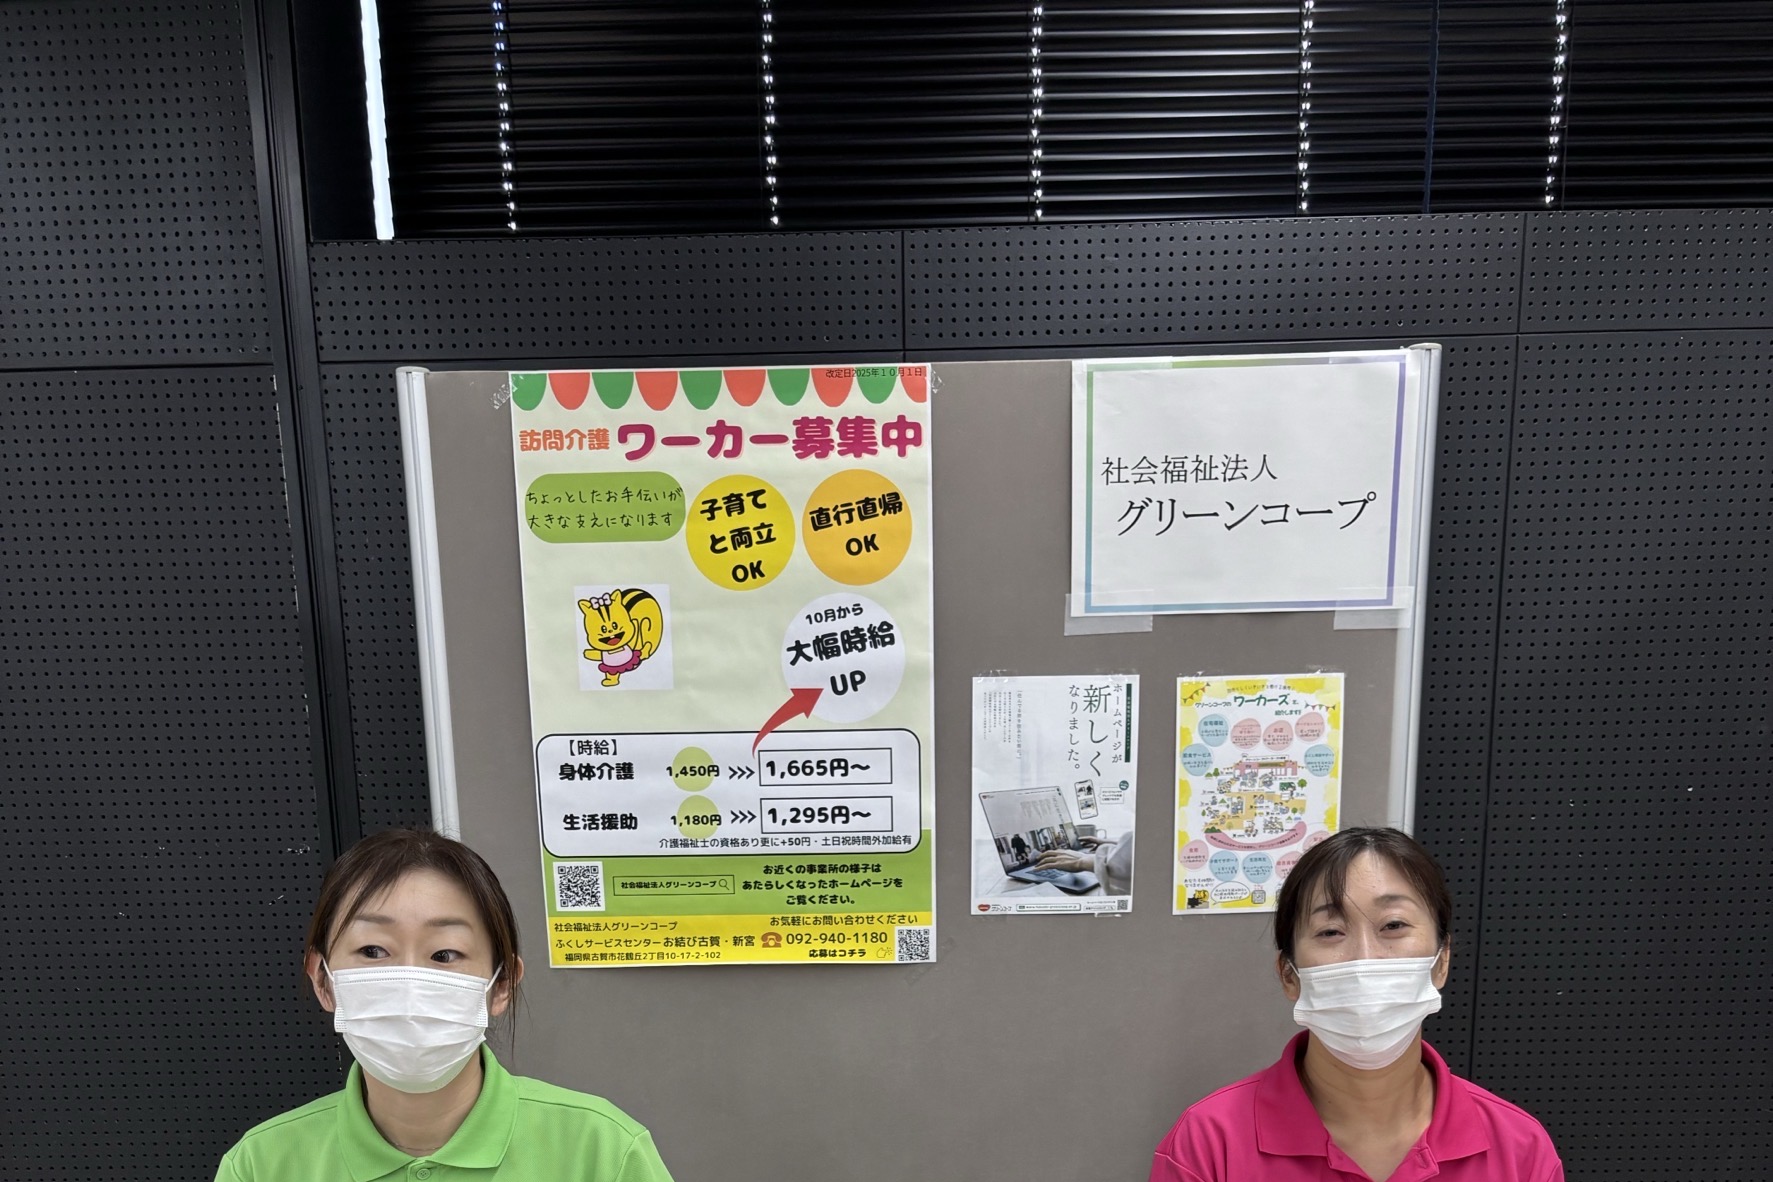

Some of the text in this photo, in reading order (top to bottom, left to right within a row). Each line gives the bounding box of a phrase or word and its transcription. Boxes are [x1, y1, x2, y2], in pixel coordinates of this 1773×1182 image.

[519, 414, 923, 462] 訪問介護 ワーカー募集中
[1100, 453, 1278, 486] 社会福祉法人
[526, 486, 684, 505] ちょっとしたお手伝いが
[700, 488, 767, 522] 子育て
[528, 511, 674, 531] 大きな支えになります
[809, 491, 903, 532] 直行直帰
[1117, 491, 1377, 537] グリーンコープ
[709, 522, 777, 555] と両立
[846, 533, 880, 557] OK
[731, 559, 766, 583] OK
[805, 602, 864, 626] 10月から
[786, 620, 896, 667] 大幅時給
[829, 670, 867, 697] UP
[1233, 693, 1290, 709] ワーカーズ
[1067, 684, 1081, 771] なりました。
[1083, 684, 1112, 778] 新しく
[1111, 683, 1123, 764] ホームページが
[569, 739, 618, 757] 【時給】
[559, 758, 871, 781] 身体介護 1,450円 1,665円～
[562, 805, 872, 831] 生活援助 1,180円 1,295円～
[763, 863, 882, 875] お近くの事業所の様子は
[620, 880, 717, 889] 社会福祉法人グリーンコープ
[742, 878, 903, 891] あたらしくなったホームページを
[786, 894, 857, 906] ご覧ください。
[554, 920, 678, 933] 社会福祉法人グリーンコープ
[769, 914, 918, 927] お気軽にお問い合わせください
[786, 931, 888, 946] 092-940-1180
[808, 948, 867, 959] 応募はコチラ
